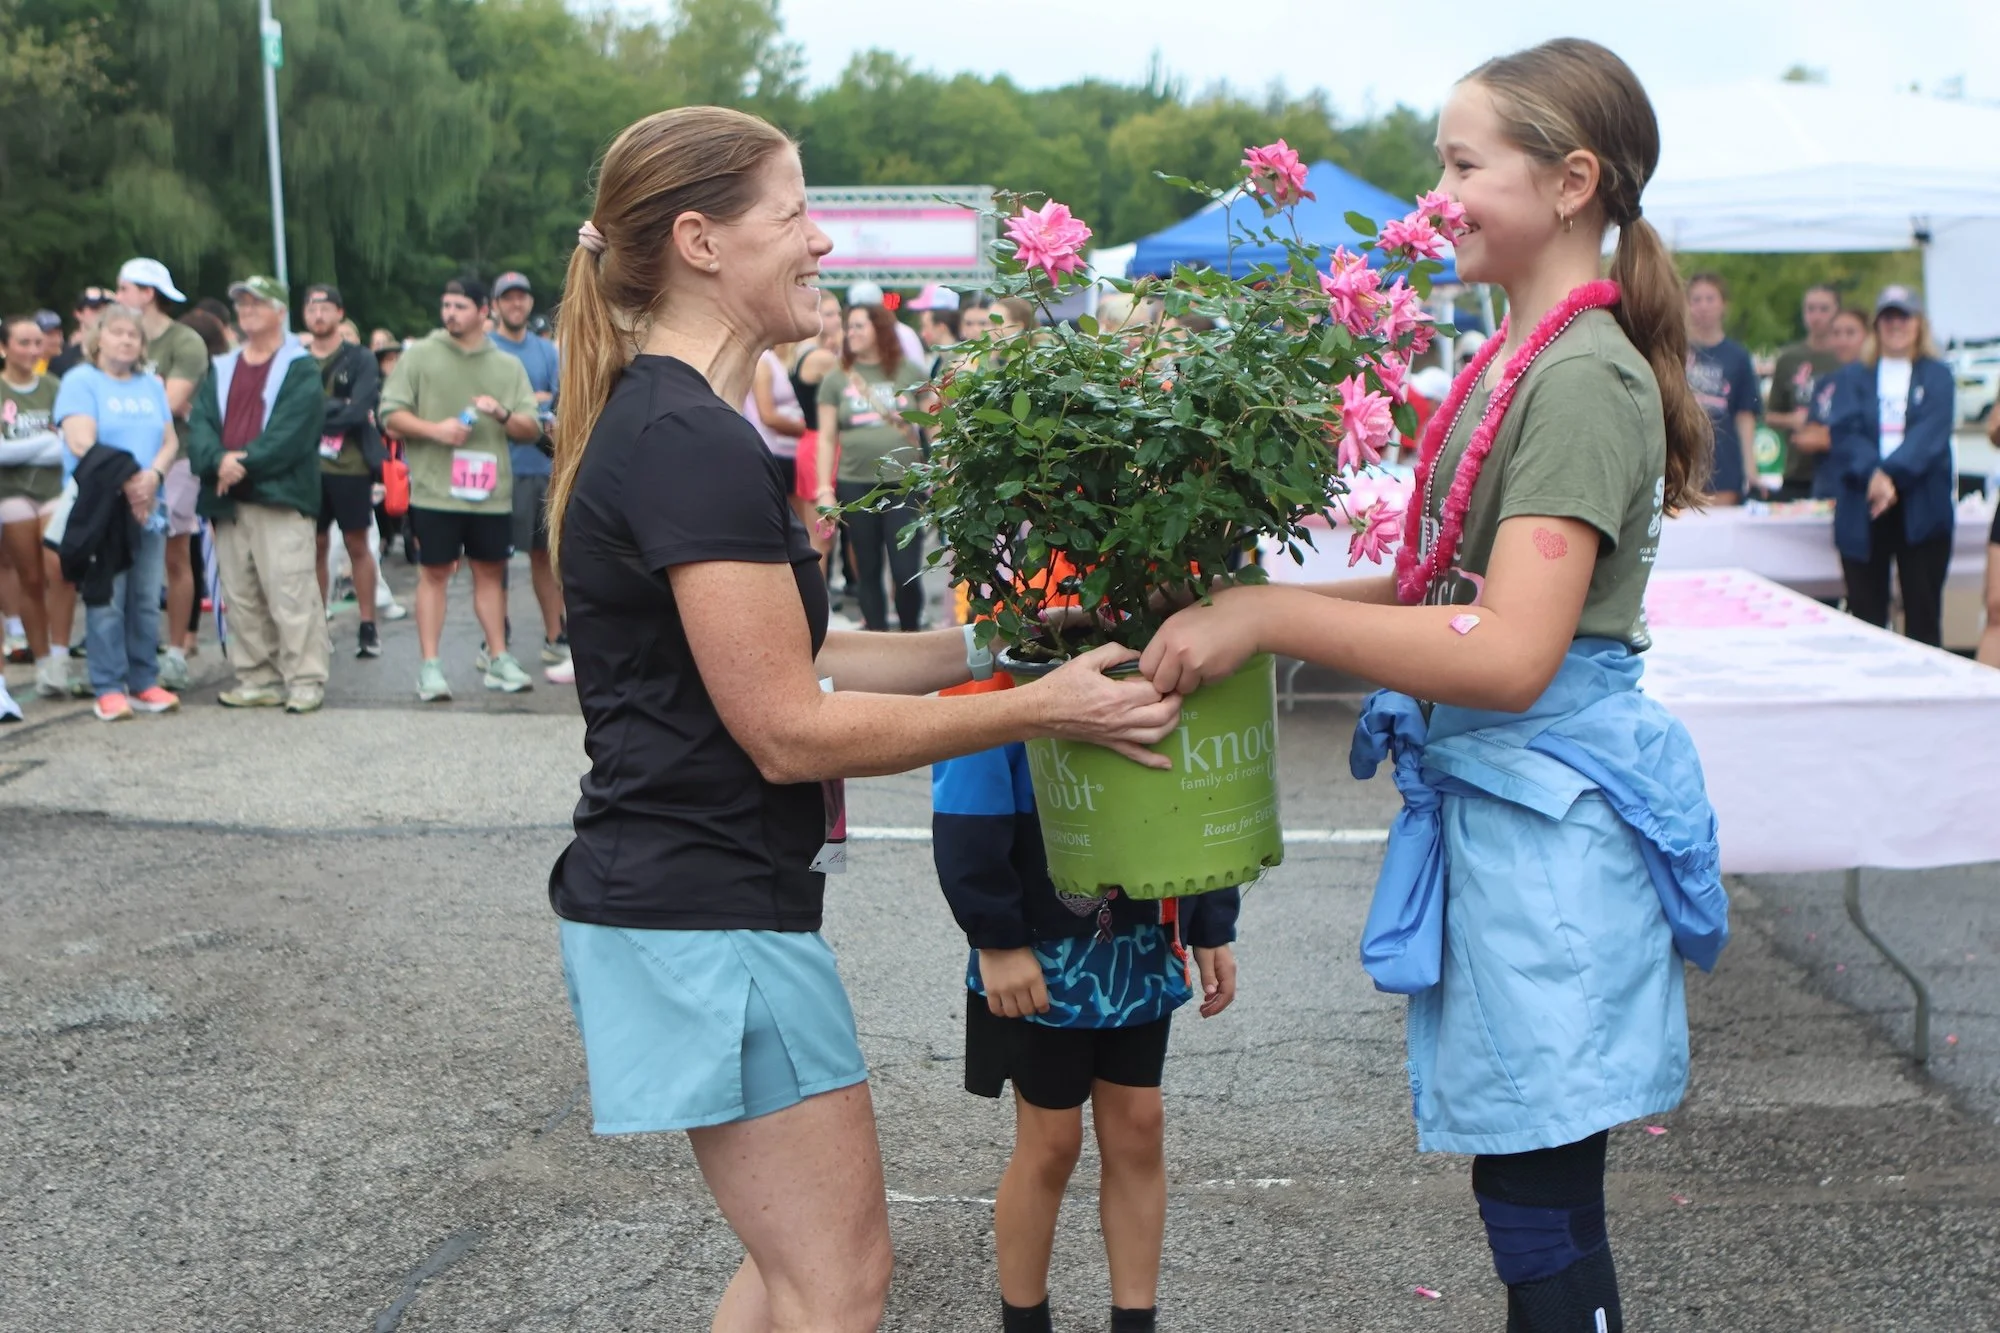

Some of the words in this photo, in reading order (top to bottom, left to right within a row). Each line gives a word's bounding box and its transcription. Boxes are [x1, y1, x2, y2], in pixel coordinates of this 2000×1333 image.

[461, 471, 490, 489] 117
[1181, 708, 1200, 721] he
[1176, 720, 1276, 773] knoc
[1180, 773, 1222, 790] family
[1226, 767, 1239, 782] of
[1202, 823, 1237, 837] Roses
[1237, 815, 1253, 834] for
